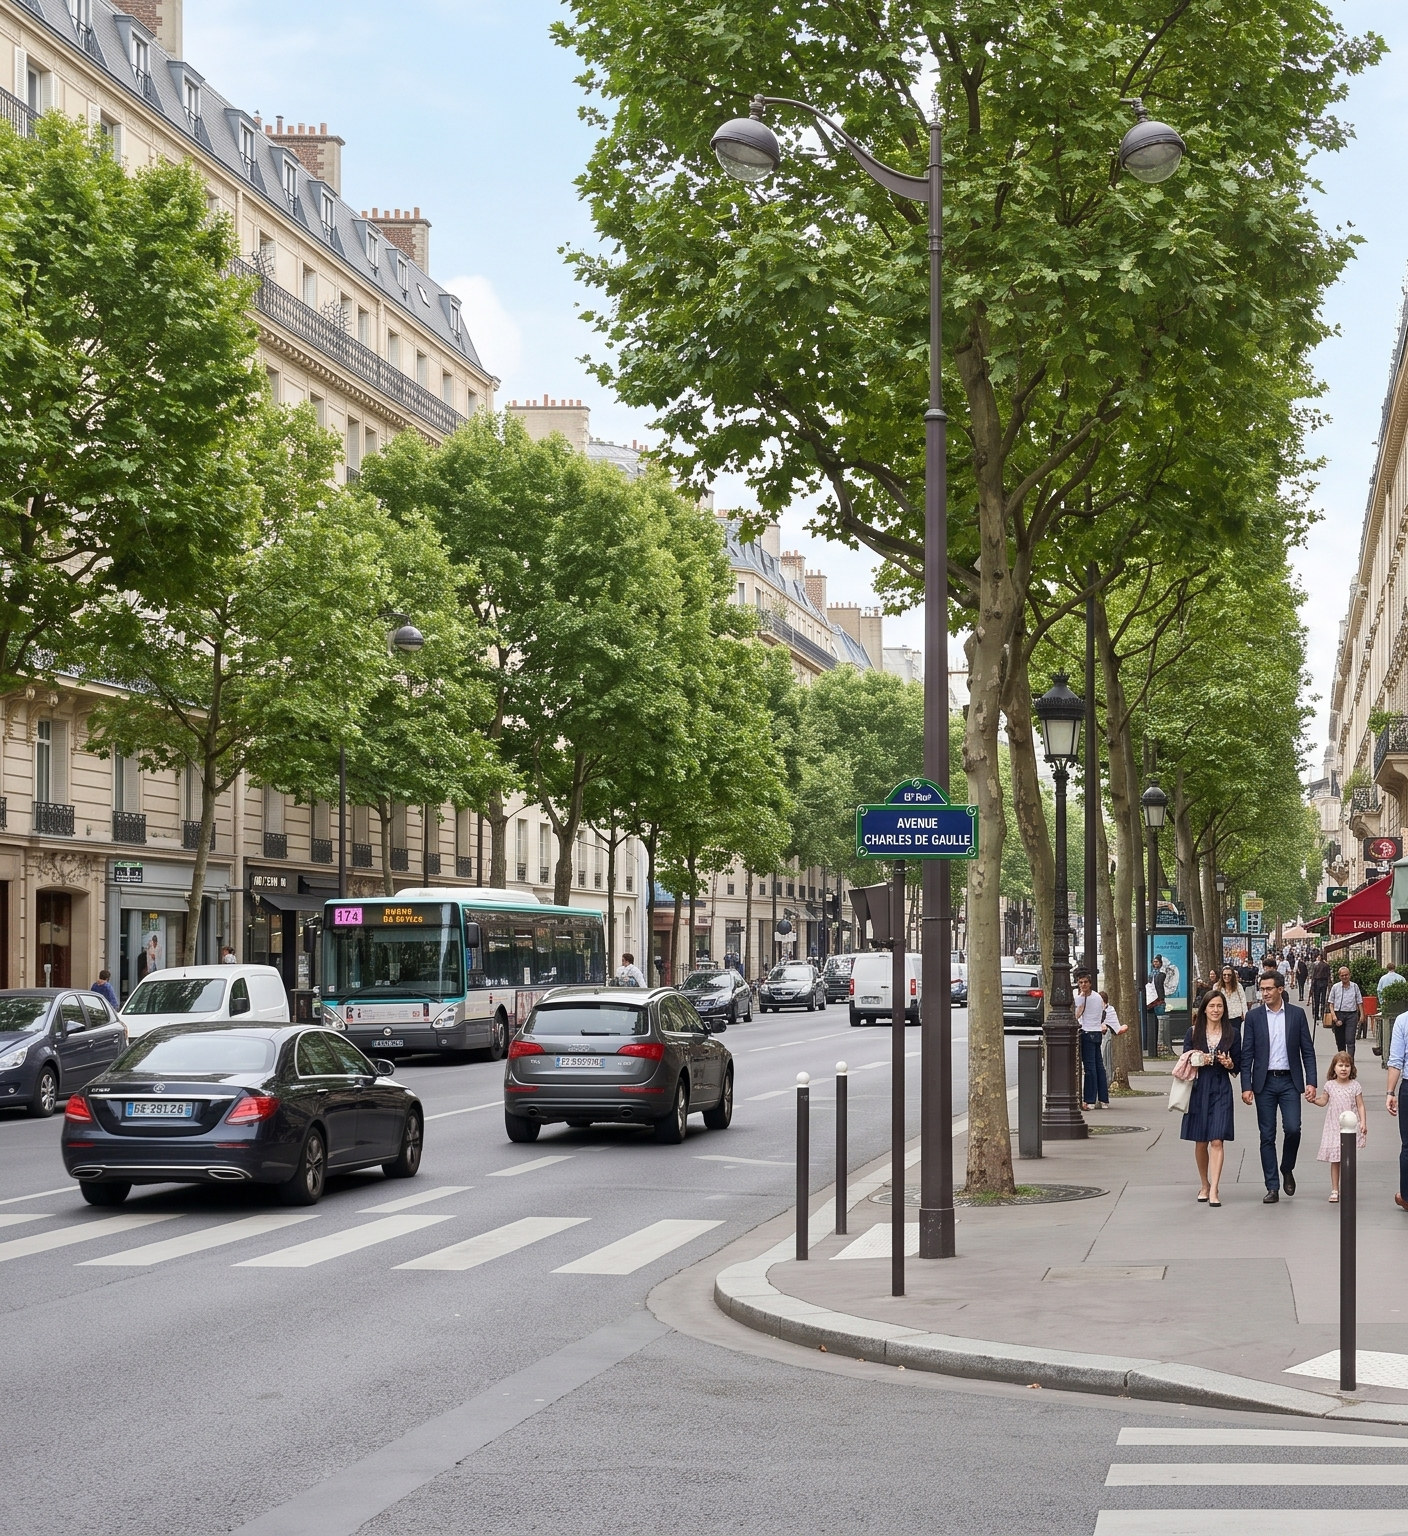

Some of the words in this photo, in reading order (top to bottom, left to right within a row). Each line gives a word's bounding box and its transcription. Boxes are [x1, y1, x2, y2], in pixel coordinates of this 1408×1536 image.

[896, 817, 938, 829] AVENUE
[864, 834, 912, 846] CHARLES
[915, 834, 929, 845] DE
[931, 834, 971, 846] GAULLE
[337, 910, 359, 922] 174
